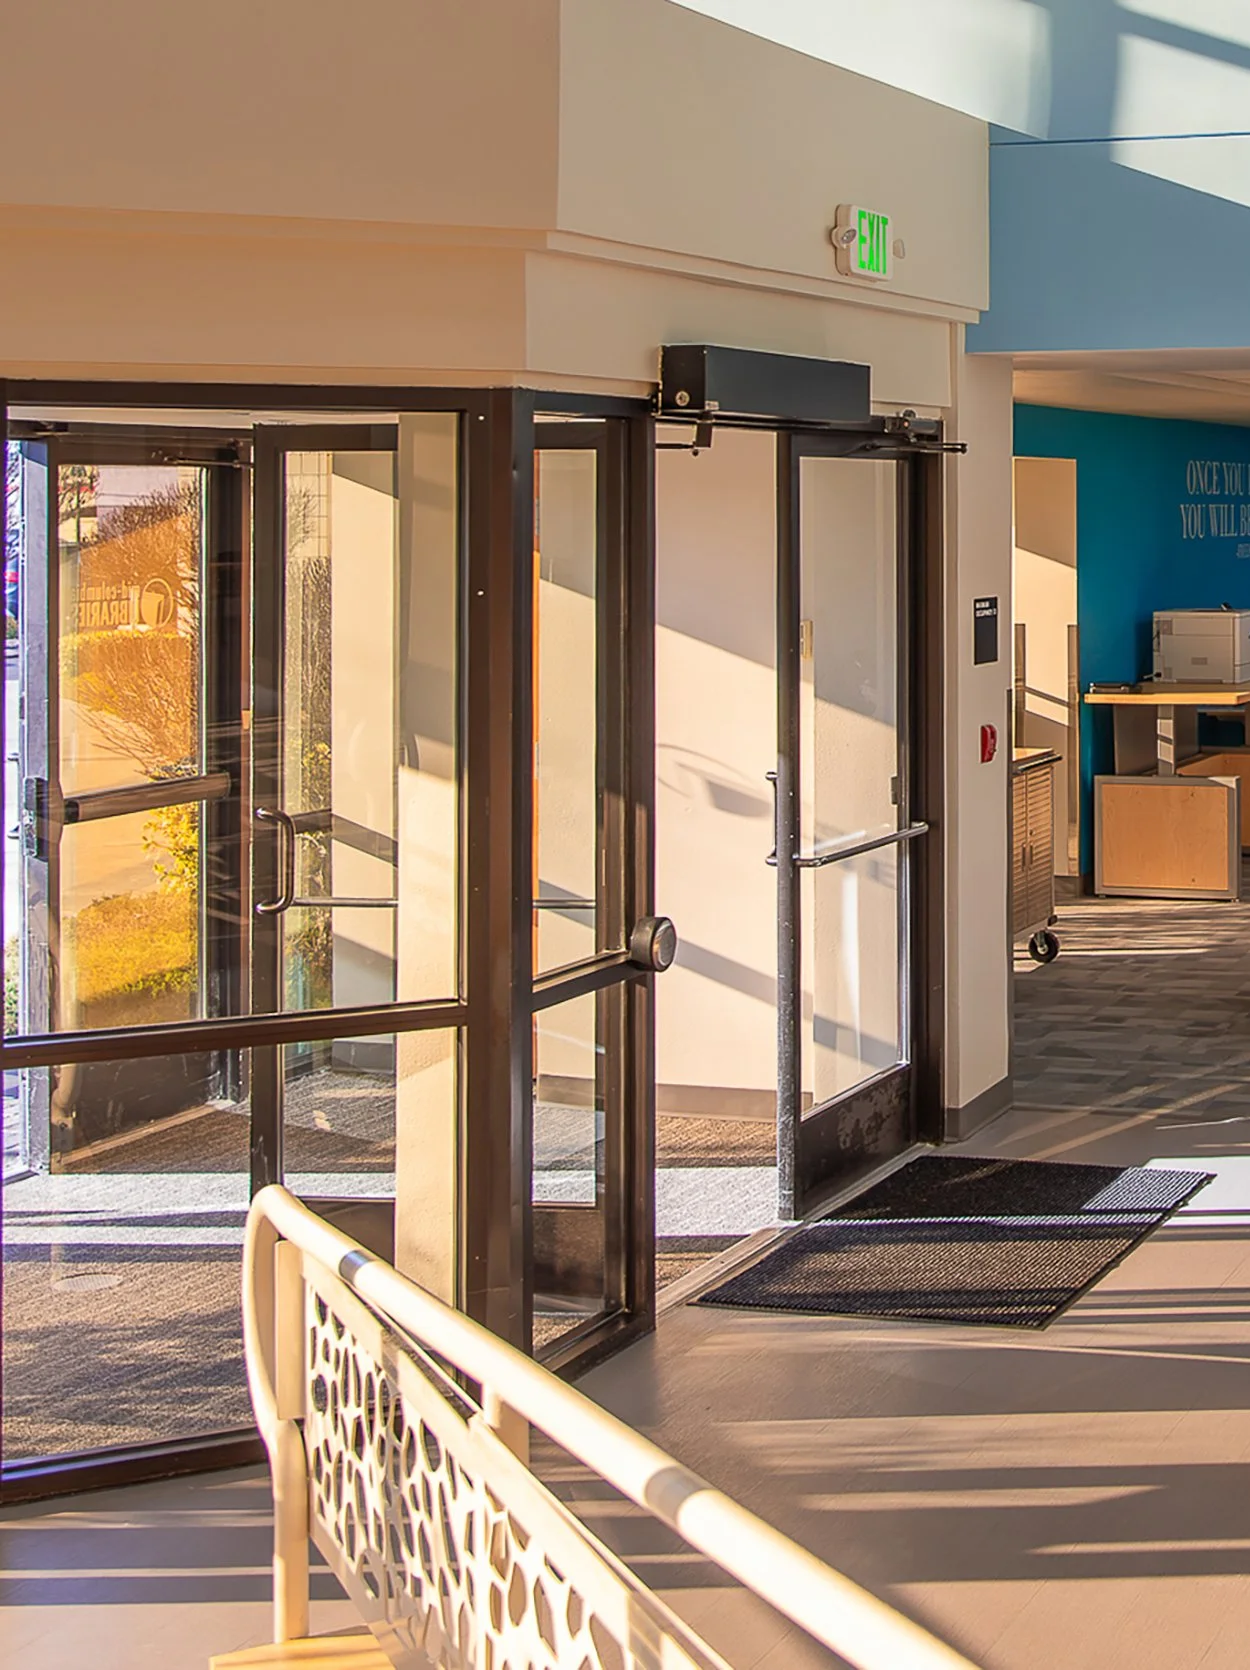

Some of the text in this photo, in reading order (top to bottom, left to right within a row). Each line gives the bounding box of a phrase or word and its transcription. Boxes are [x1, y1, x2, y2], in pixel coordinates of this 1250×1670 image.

[858, 209, 888, 275] EXIT
[1186, 460, 1220, 495] ONCE
[1222, 462, 1246, 496] YOU
[1180, 503, 1205, 539] YOU
[1208, 503, 1238, 537] WILL
